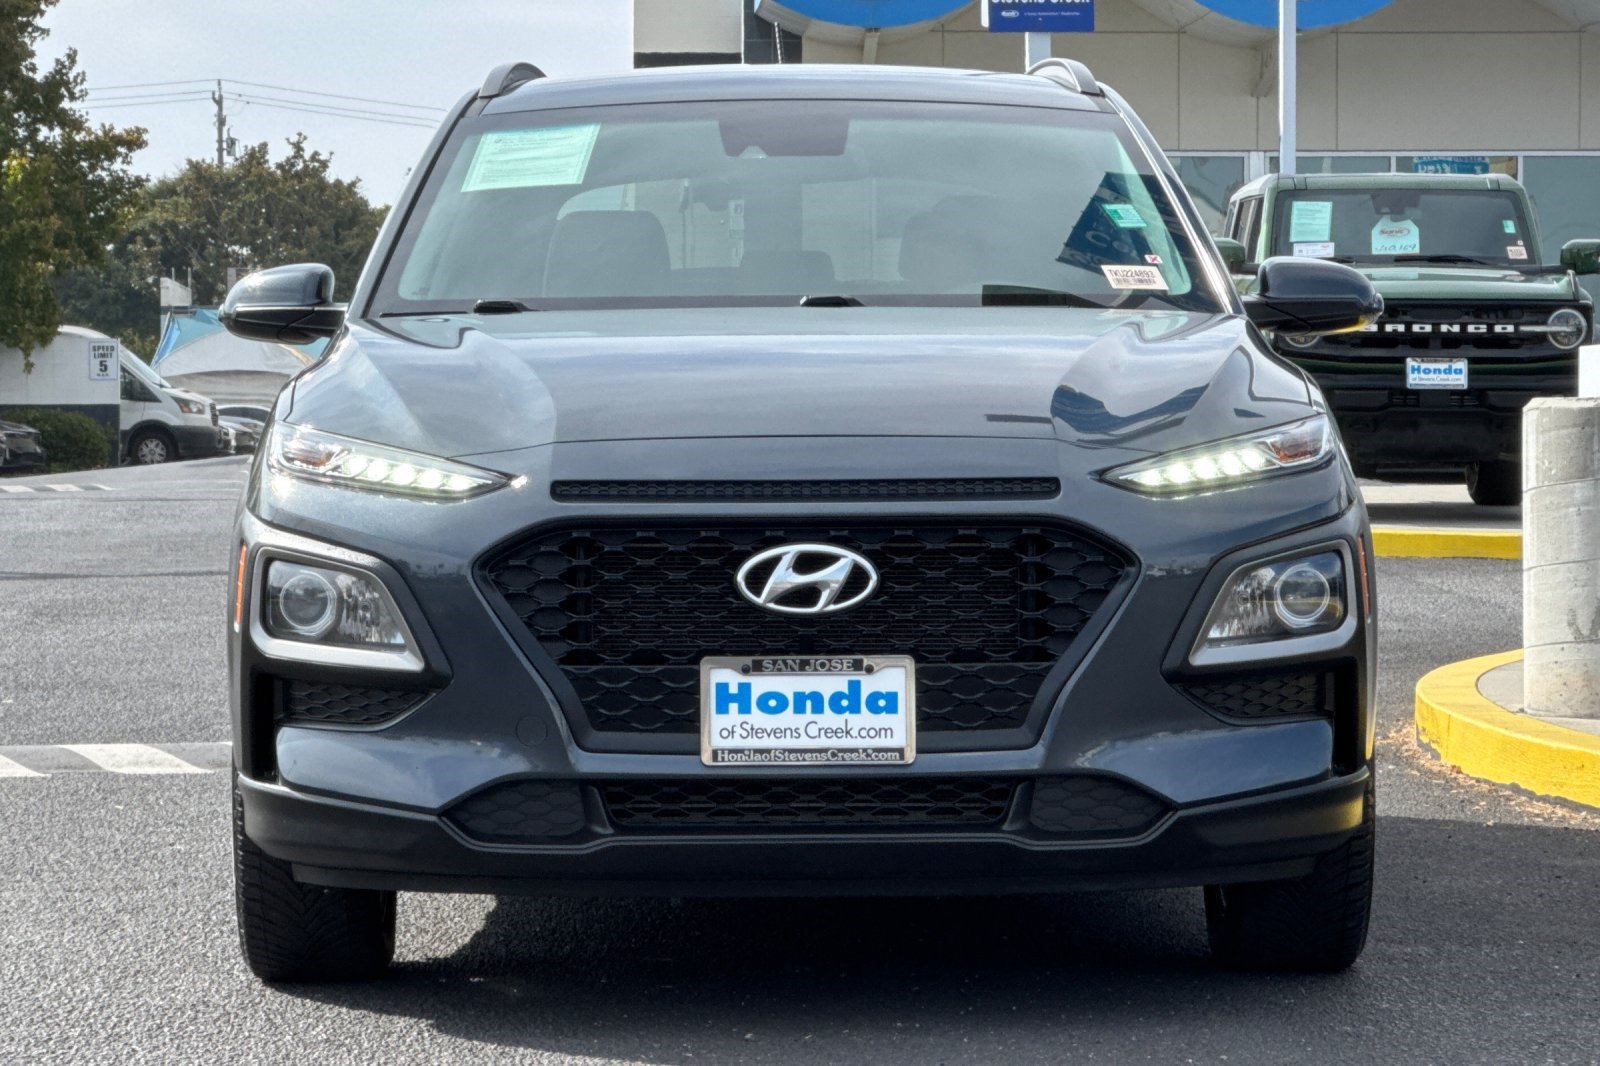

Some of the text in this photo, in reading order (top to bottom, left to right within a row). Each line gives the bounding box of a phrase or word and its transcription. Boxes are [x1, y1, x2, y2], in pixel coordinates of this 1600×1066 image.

[99, 360, 108, 372] 5
[1411, 364, 1463, 375] Honda
[761, 659, 854, 672] SAN JOSE
[715, 679, 899, 715] Honda
[719, 718, 893, 739] of Stevens Creek.com
[717, 749, 900, 762] HondaofStevensCreek.com
